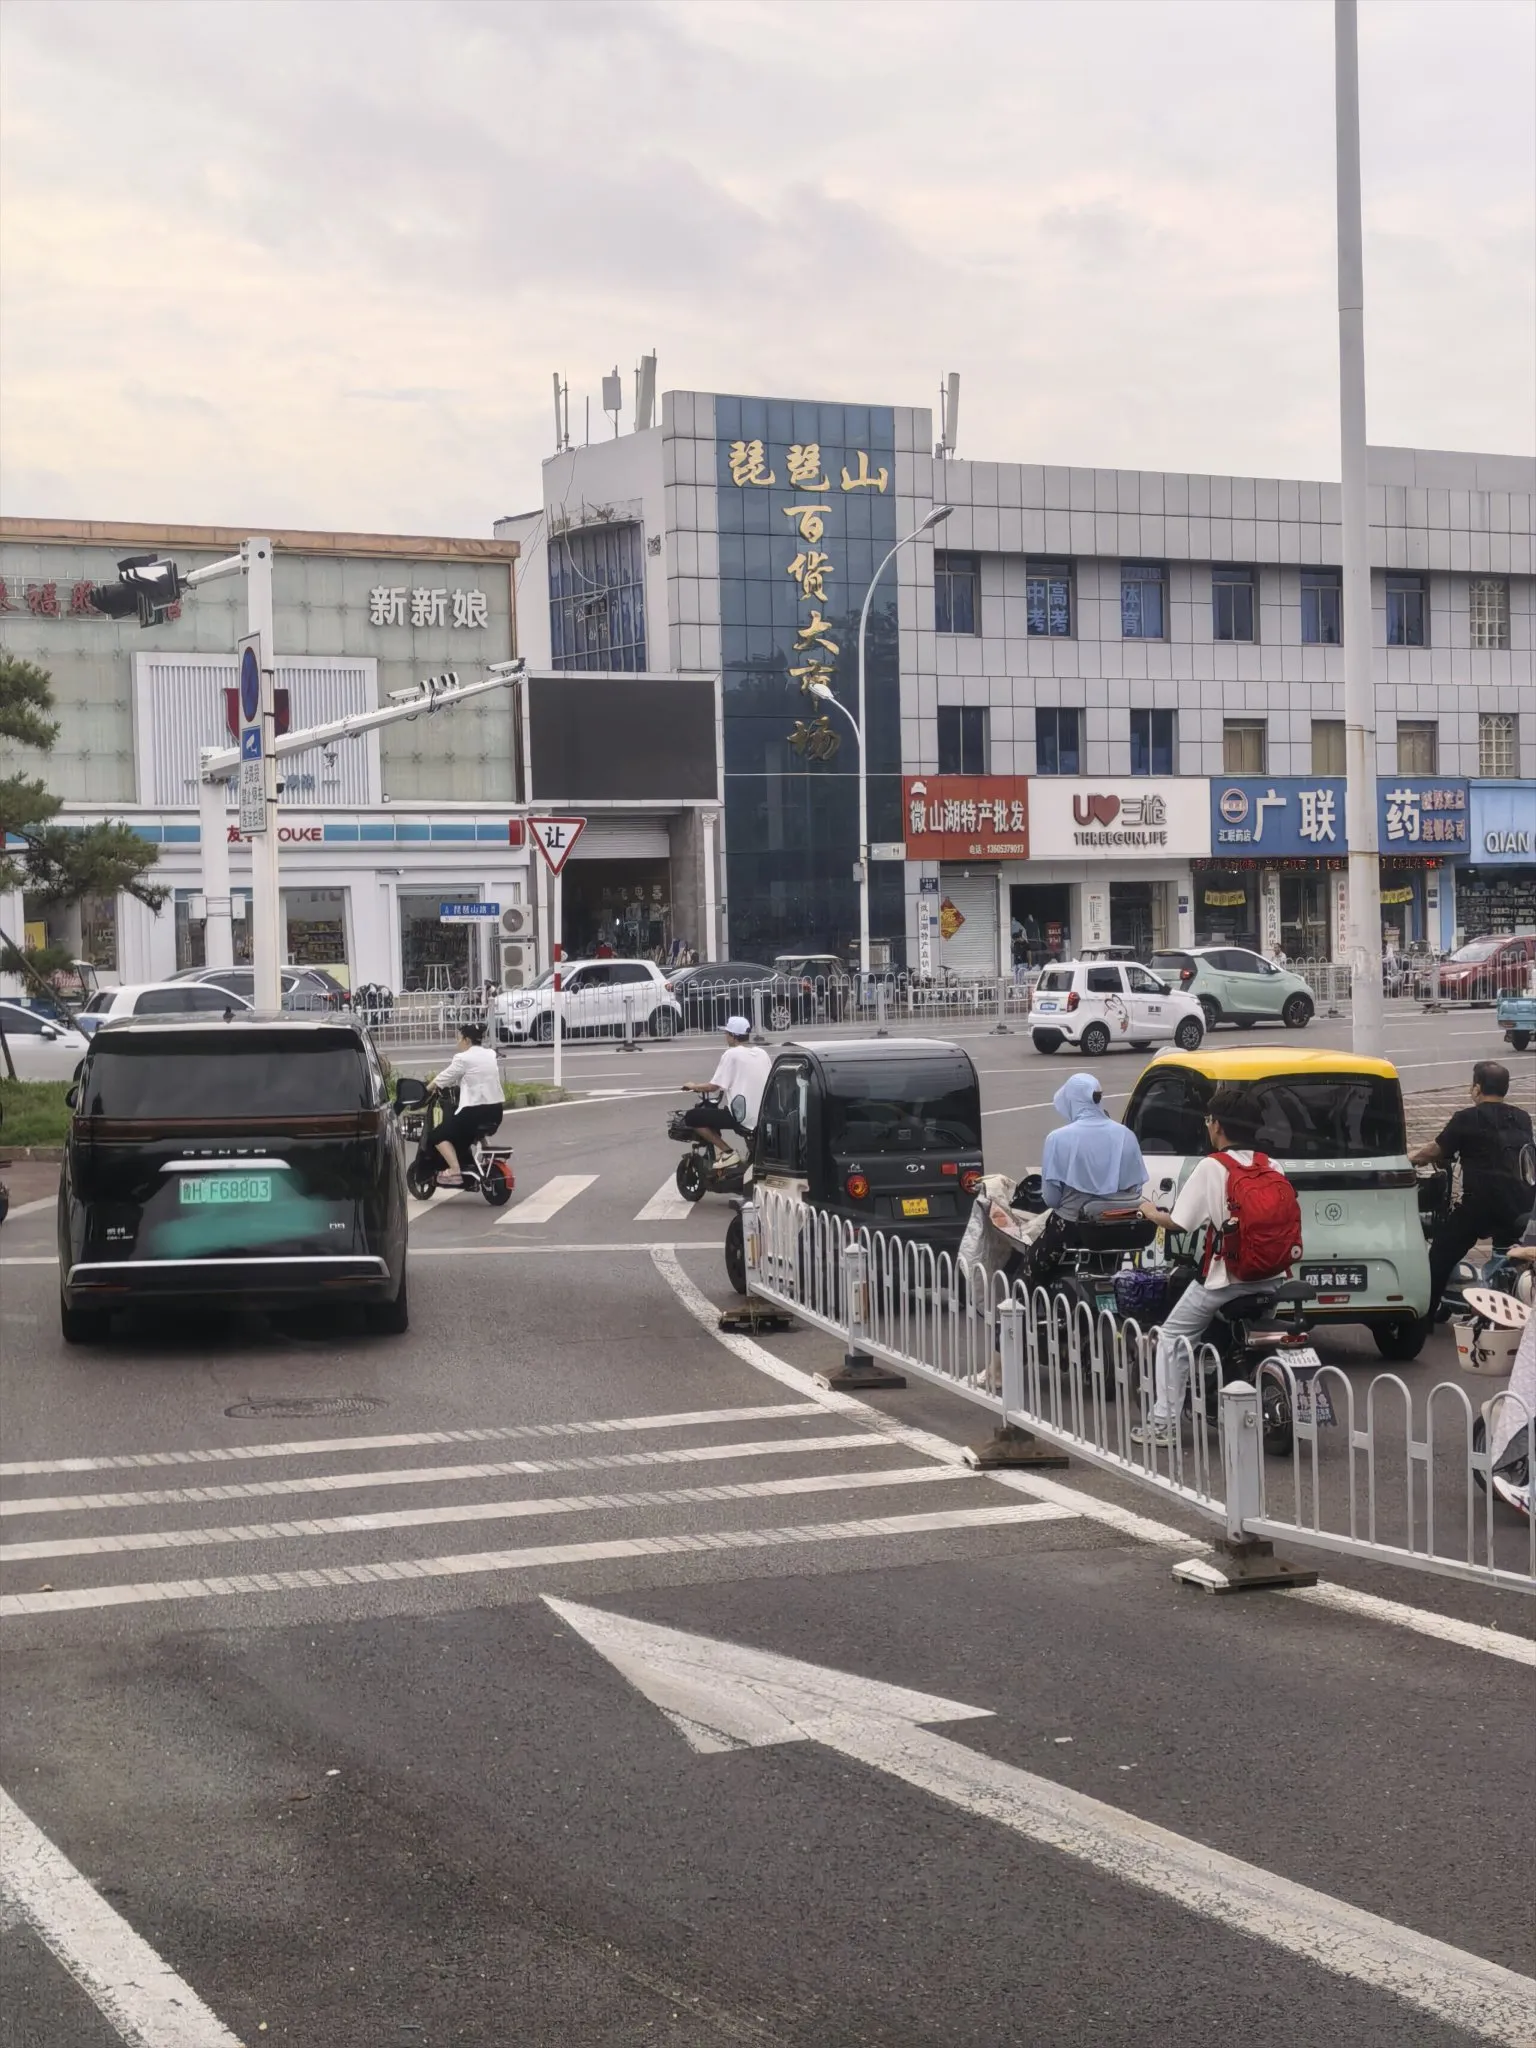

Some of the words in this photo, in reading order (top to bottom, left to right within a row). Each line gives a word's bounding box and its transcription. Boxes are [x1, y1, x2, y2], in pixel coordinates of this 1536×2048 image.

[729, 439, 888, 493] 琵琶山
[369, 585, 489, 628] 新新娘
[1122, 584, 1141, 634] 体育
[910, 799, 1025, 833] 微山湖特产批发
[1121, 794, 1167, 826] 三枪
[1252, 788, 1420, 842] 广联药
[276, 827, 323, 842] OUKE
[545, 826, 565, 848] 让
[1073, 831, 1167, 846] THREEGUNLIFE
[1218, 829, 1251, 842] 汇联药店
[1486, 831, 1530, 853] QIAN
